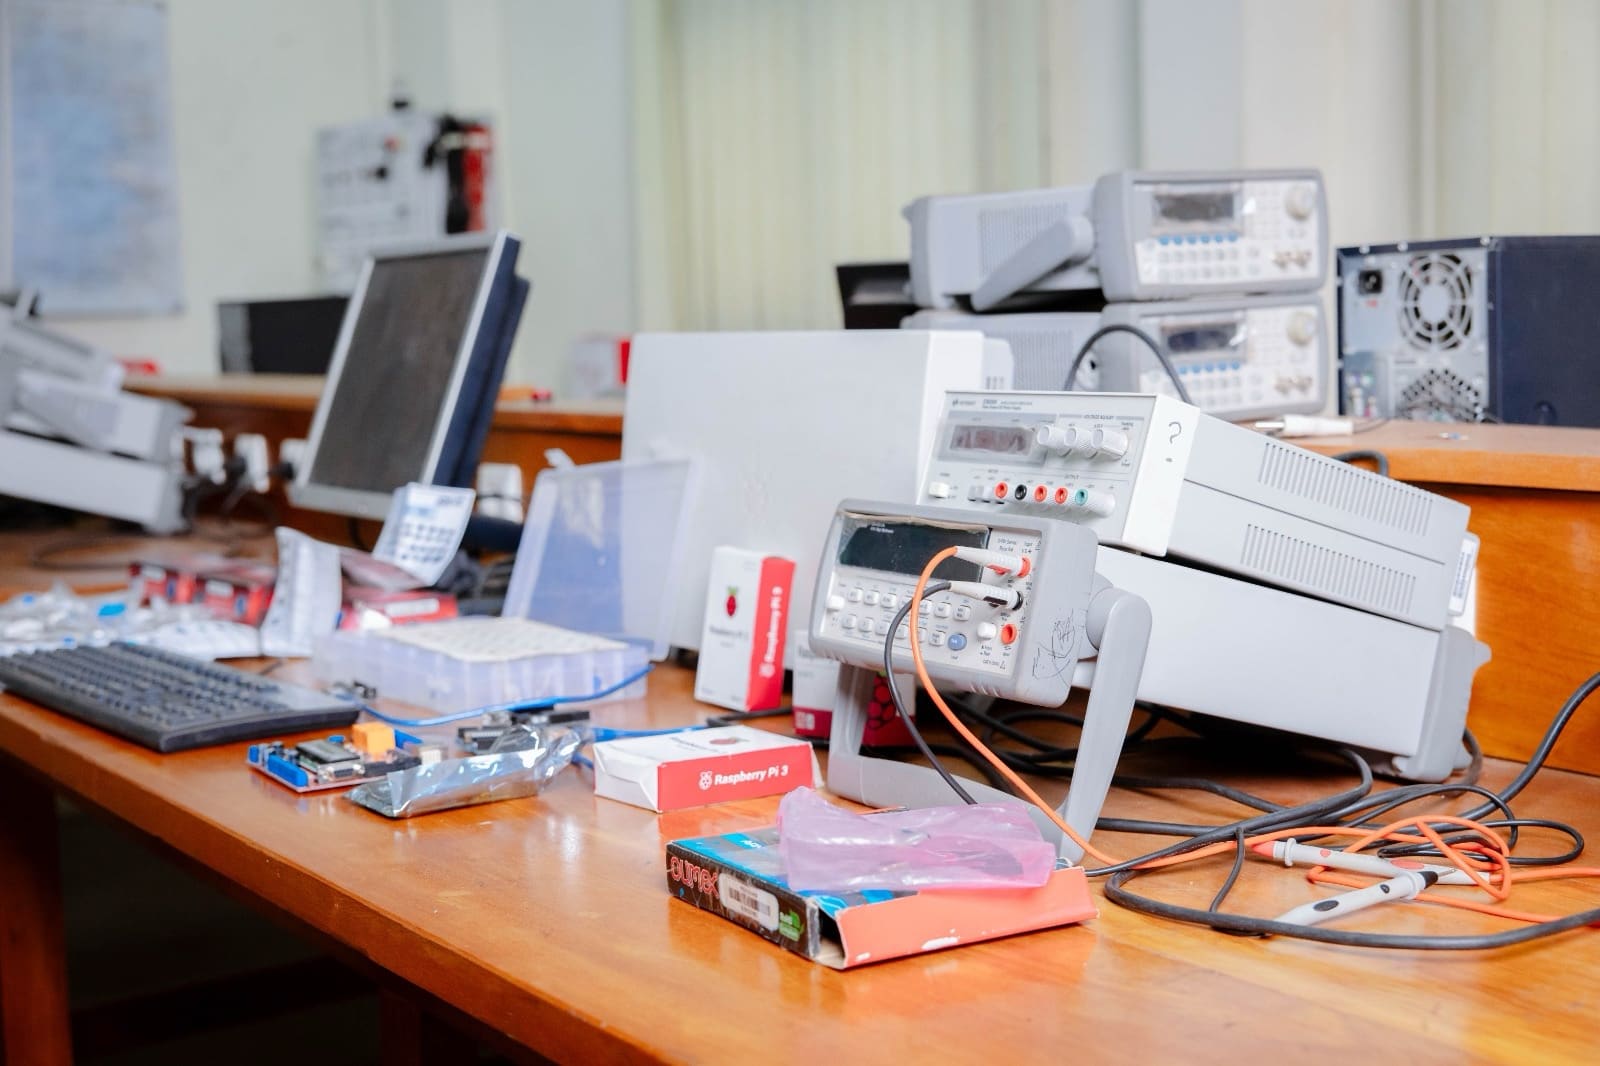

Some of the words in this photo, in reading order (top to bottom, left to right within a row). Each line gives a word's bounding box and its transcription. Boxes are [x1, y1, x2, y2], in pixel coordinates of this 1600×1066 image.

[714, 770, 767, 786] Raspberry
[767, 766, 779, 778] Pi
[780, 764, 789, 777] 3
